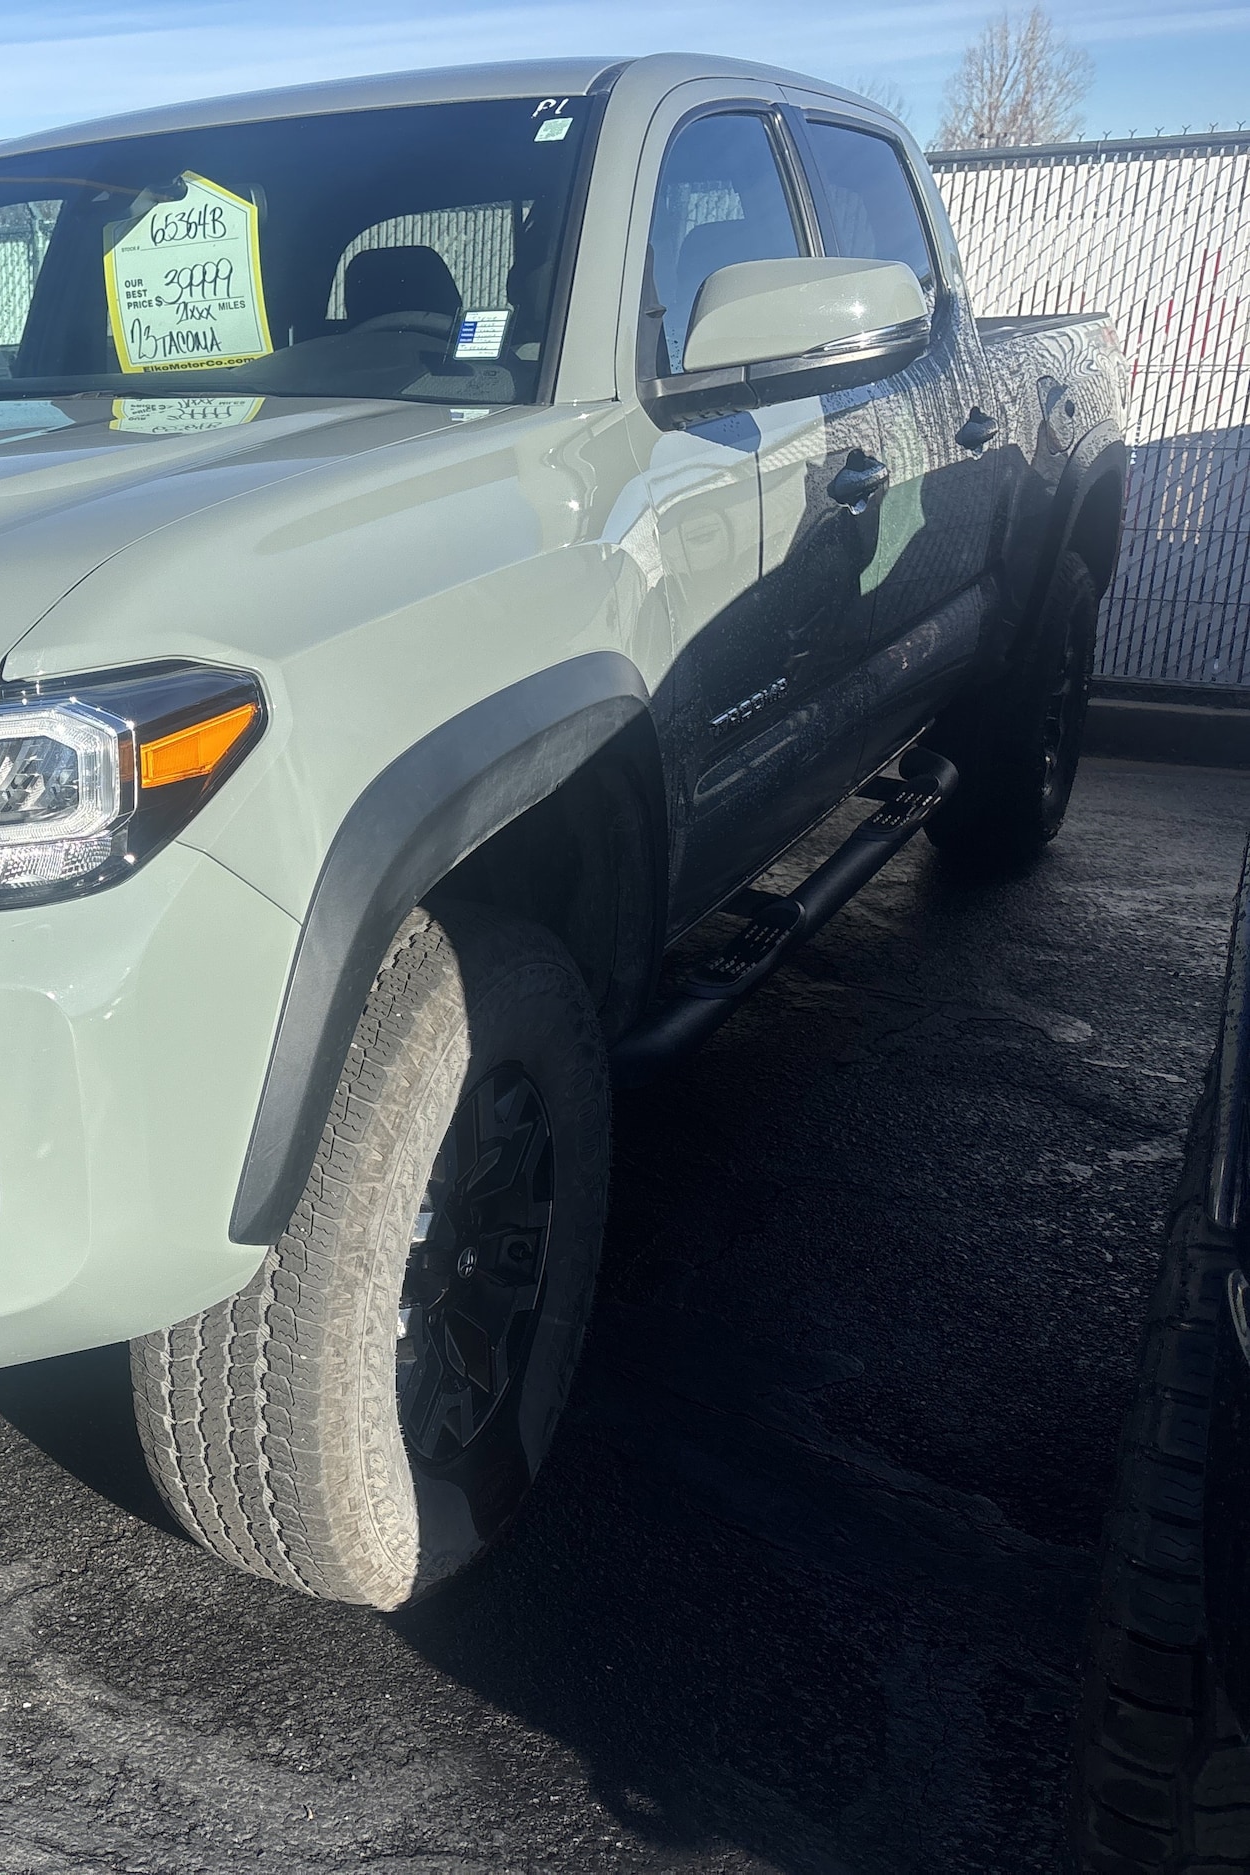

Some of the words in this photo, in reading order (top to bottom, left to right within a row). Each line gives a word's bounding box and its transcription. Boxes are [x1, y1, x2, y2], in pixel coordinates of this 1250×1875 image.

[124, 279, 144, 288] OUR
[125, 289, 148, 300] BEST
[126, 300, 154, 310] PRICE
[218, 300, 246, 312] MILES
[142, 356, 256, 373] ElkoMotorCo.com
